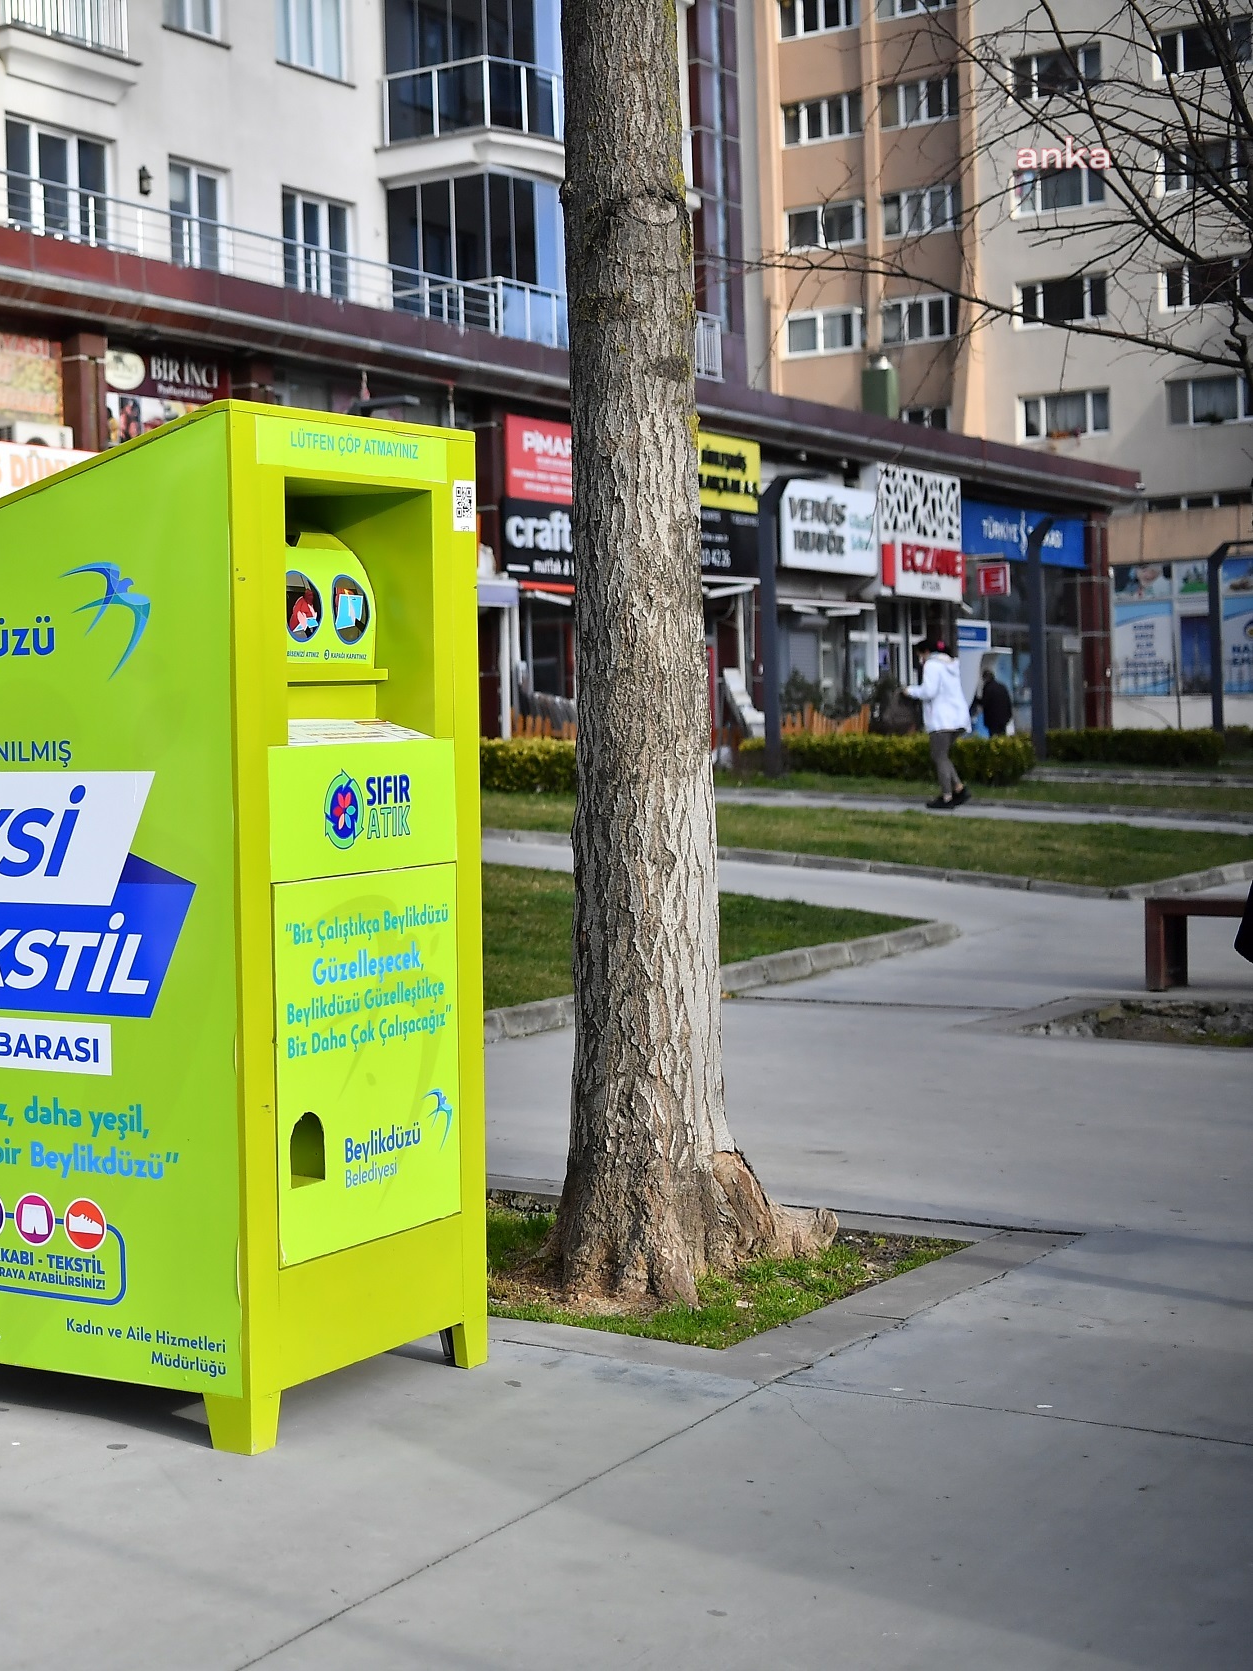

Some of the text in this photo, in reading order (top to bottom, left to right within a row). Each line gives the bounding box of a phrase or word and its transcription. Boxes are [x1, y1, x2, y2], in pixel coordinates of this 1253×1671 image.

[290, 428, 419, 460] LÜTFEN ÇÖP ATMAYINIZ
[366, 774, 410, 806] SIFIR
[367, 805, 410, 839] ATIK
[317, 913, 380, 948] Çalıştıkça
[383, 904, 449, 934] Beylikdüzü
[312, 941, 424, 985] Güzelleşecek,
[287, 977, 445, 1027] Beylikdüzü Güzelleştikçe
[287, 1036, 308, 1059] Biz
[311, 1028, 347, 1054] Daha
[350, 1020, 375, 1052] Çok
[23, 1095, 83, 1128] daha
[88, 1103, 150, 1141] yeşil,
[344, 1121, 421, 1164] Beylikdüzü
[345, 1157, 398, 1188] Belediyesi
[28, 1270, 106, 1290] ATABİLİRSİNİZ!
[46, 1254, 106, 1275] TEKSTİL
[66, 1317, 227, 1353] Kadın ve Aile Hizmetleri
[151, 1351, 227, 1378] Müdürlüğü
